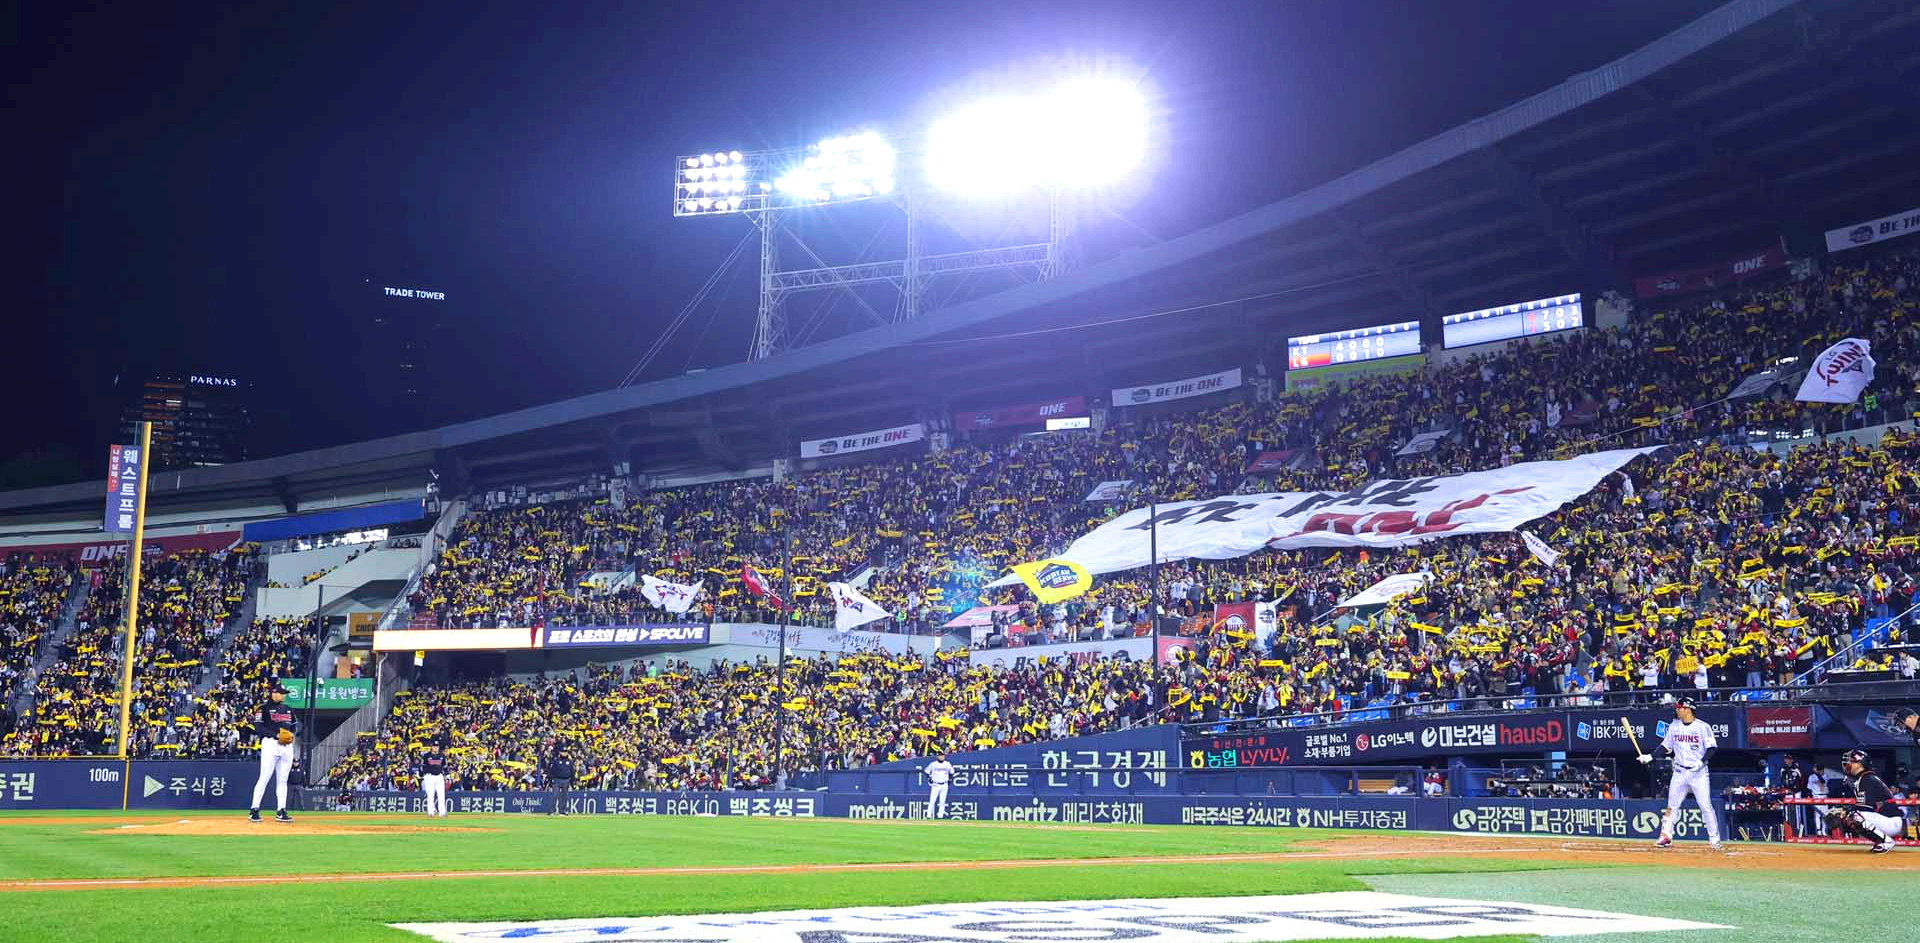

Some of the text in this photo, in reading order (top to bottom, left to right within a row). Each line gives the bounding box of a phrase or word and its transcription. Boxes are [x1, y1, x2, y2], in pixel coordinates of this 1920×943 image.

[1732, 254, 1769, 276] ONE
[384, 287, 446, 301] TRADE TOWER
[1542, 310, 1549, 320] 7
[1556, 307, 1564, 317] 0
[1570, 305, 1578, 316] 3
[1543, 321, 1550, 331] 5
[1556, 318, 1565, 328] 0
[1571, 316, 1579, 327] 2
[1292, 346, 1308, 357] KT
[1336, 342, 1343, 352] 4
[1349, 340, 1357, 349] 0
[1362, 339, 1370, 348] 0
[1293, 357, 1308, 367] LG
[1336, 352, 1344, 362] 0
[1349, 350, 1357, 360] 0
[1376, 347, 1384, 357] 0
[190, 375, 237, 387] PARNAS
[1174, 382, 1195, 396] THE
[1198, 376, 1225, 390] ONE
[1040, 402, 1068, 416] ONE
[843, 429, 911, 449] BE THE ONE
[650, 627, 704, 640] SPOLIVE
[1305, 733, 1348, 746] 글로벌 No.1
[1371, 731, 1415, 749] LG이노텍
[1439, 724, 1497, 748] 대보건설
[1674, 734, 1699, 744] TWINS
[1207, 750, 1237, 768] 농협
[88, 768, 119, 783] 100m
[1042, 750, 1167, 788] 한국경제
[169, 776, 227, 797] 주식창
[460, 796, 505, 813] 백조씽크
[605, 796, 657, 815] 백조씽크
[729, 797, 815, 818] 백조씽크
[849, 797, 905, 820] meritz
[992, 797, 1144, 825] meritz 메리츠화재
[1182, 807, 1407, 829] 미국주식은 24시간 NH투자증권
[1477, 806, 1526, 832] 금강주택
[1549, 808, 1628, 835] 금강펜테리움
[574, 904, 1622, 943] ASPER
